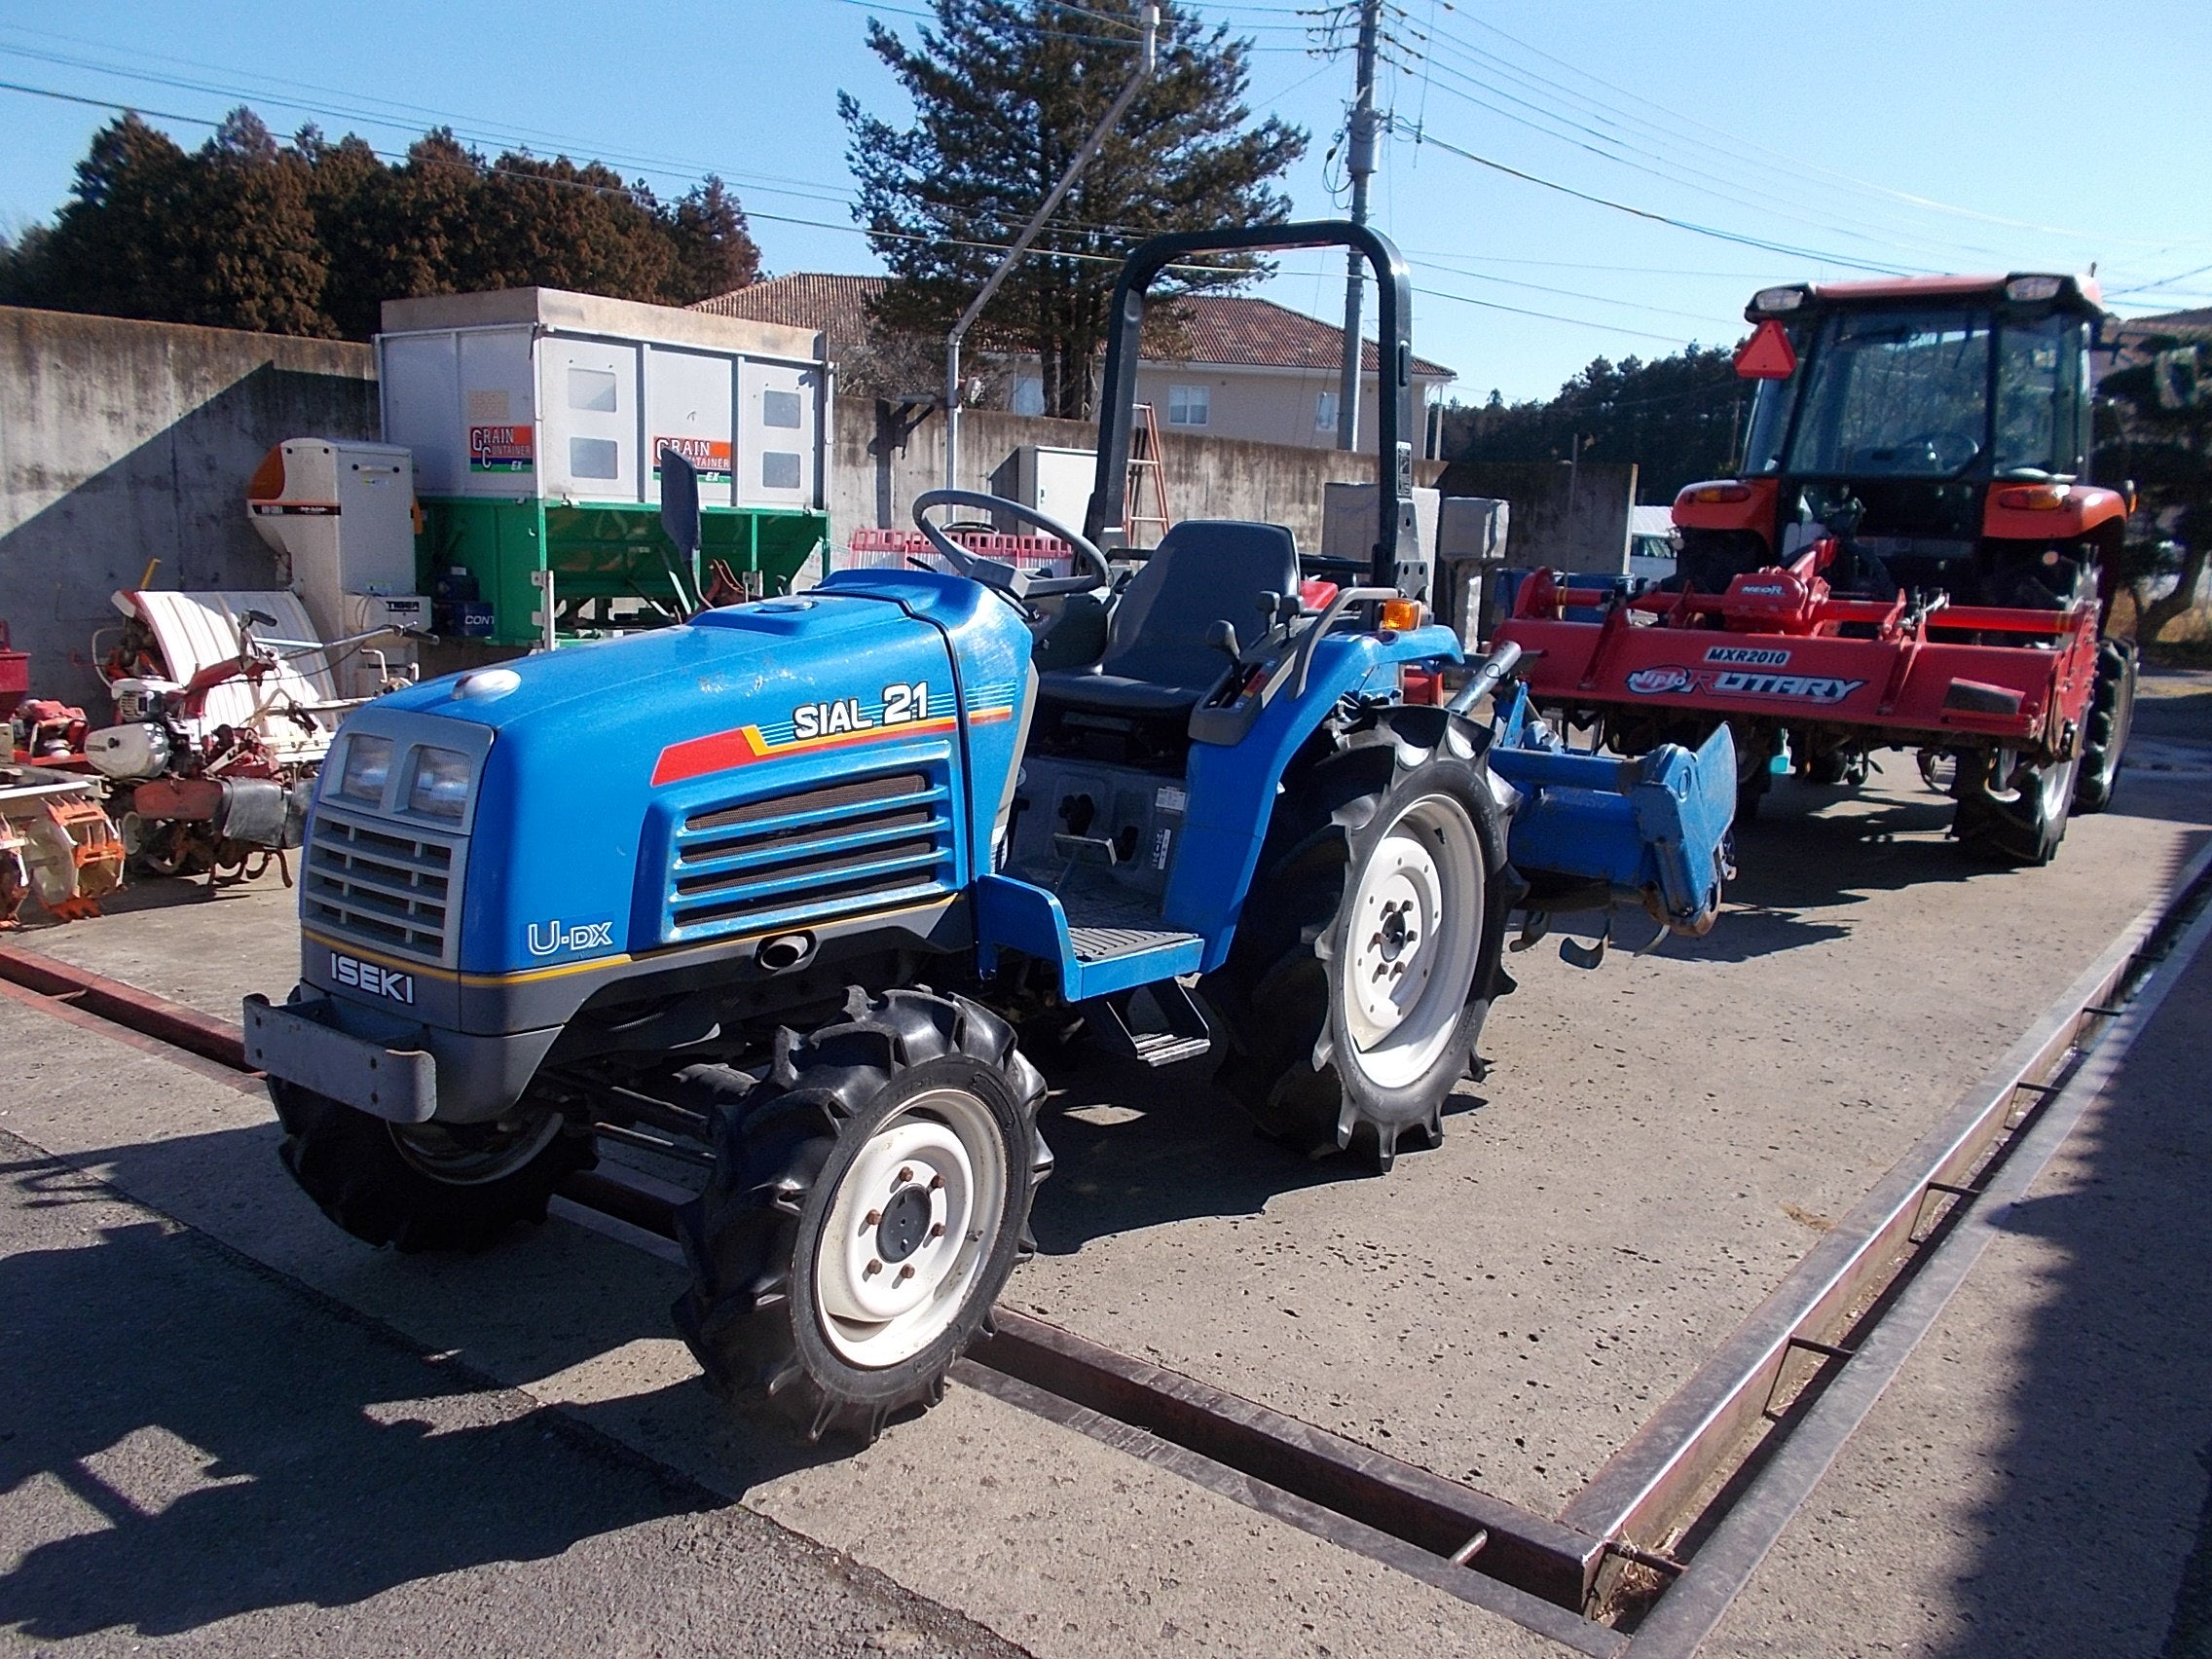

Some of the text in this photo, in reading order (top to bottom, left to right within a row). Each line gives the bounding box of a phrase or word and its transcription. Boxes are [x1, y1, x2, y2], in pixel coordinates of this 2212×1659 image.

[472, 428, 514, 452] GRAIN
[482, 446, 532, 468] CONTAINER
[510, 461, 524, 471] EX
[705, 471, 719, 482] EX
[1707, 647, 1788, 665] MXR2010
[1684, 670, 1864, 703] ROTARY
[793, 681, 929, 740] SIAL 21
[331, 952, 414, 1004] ISEKI
